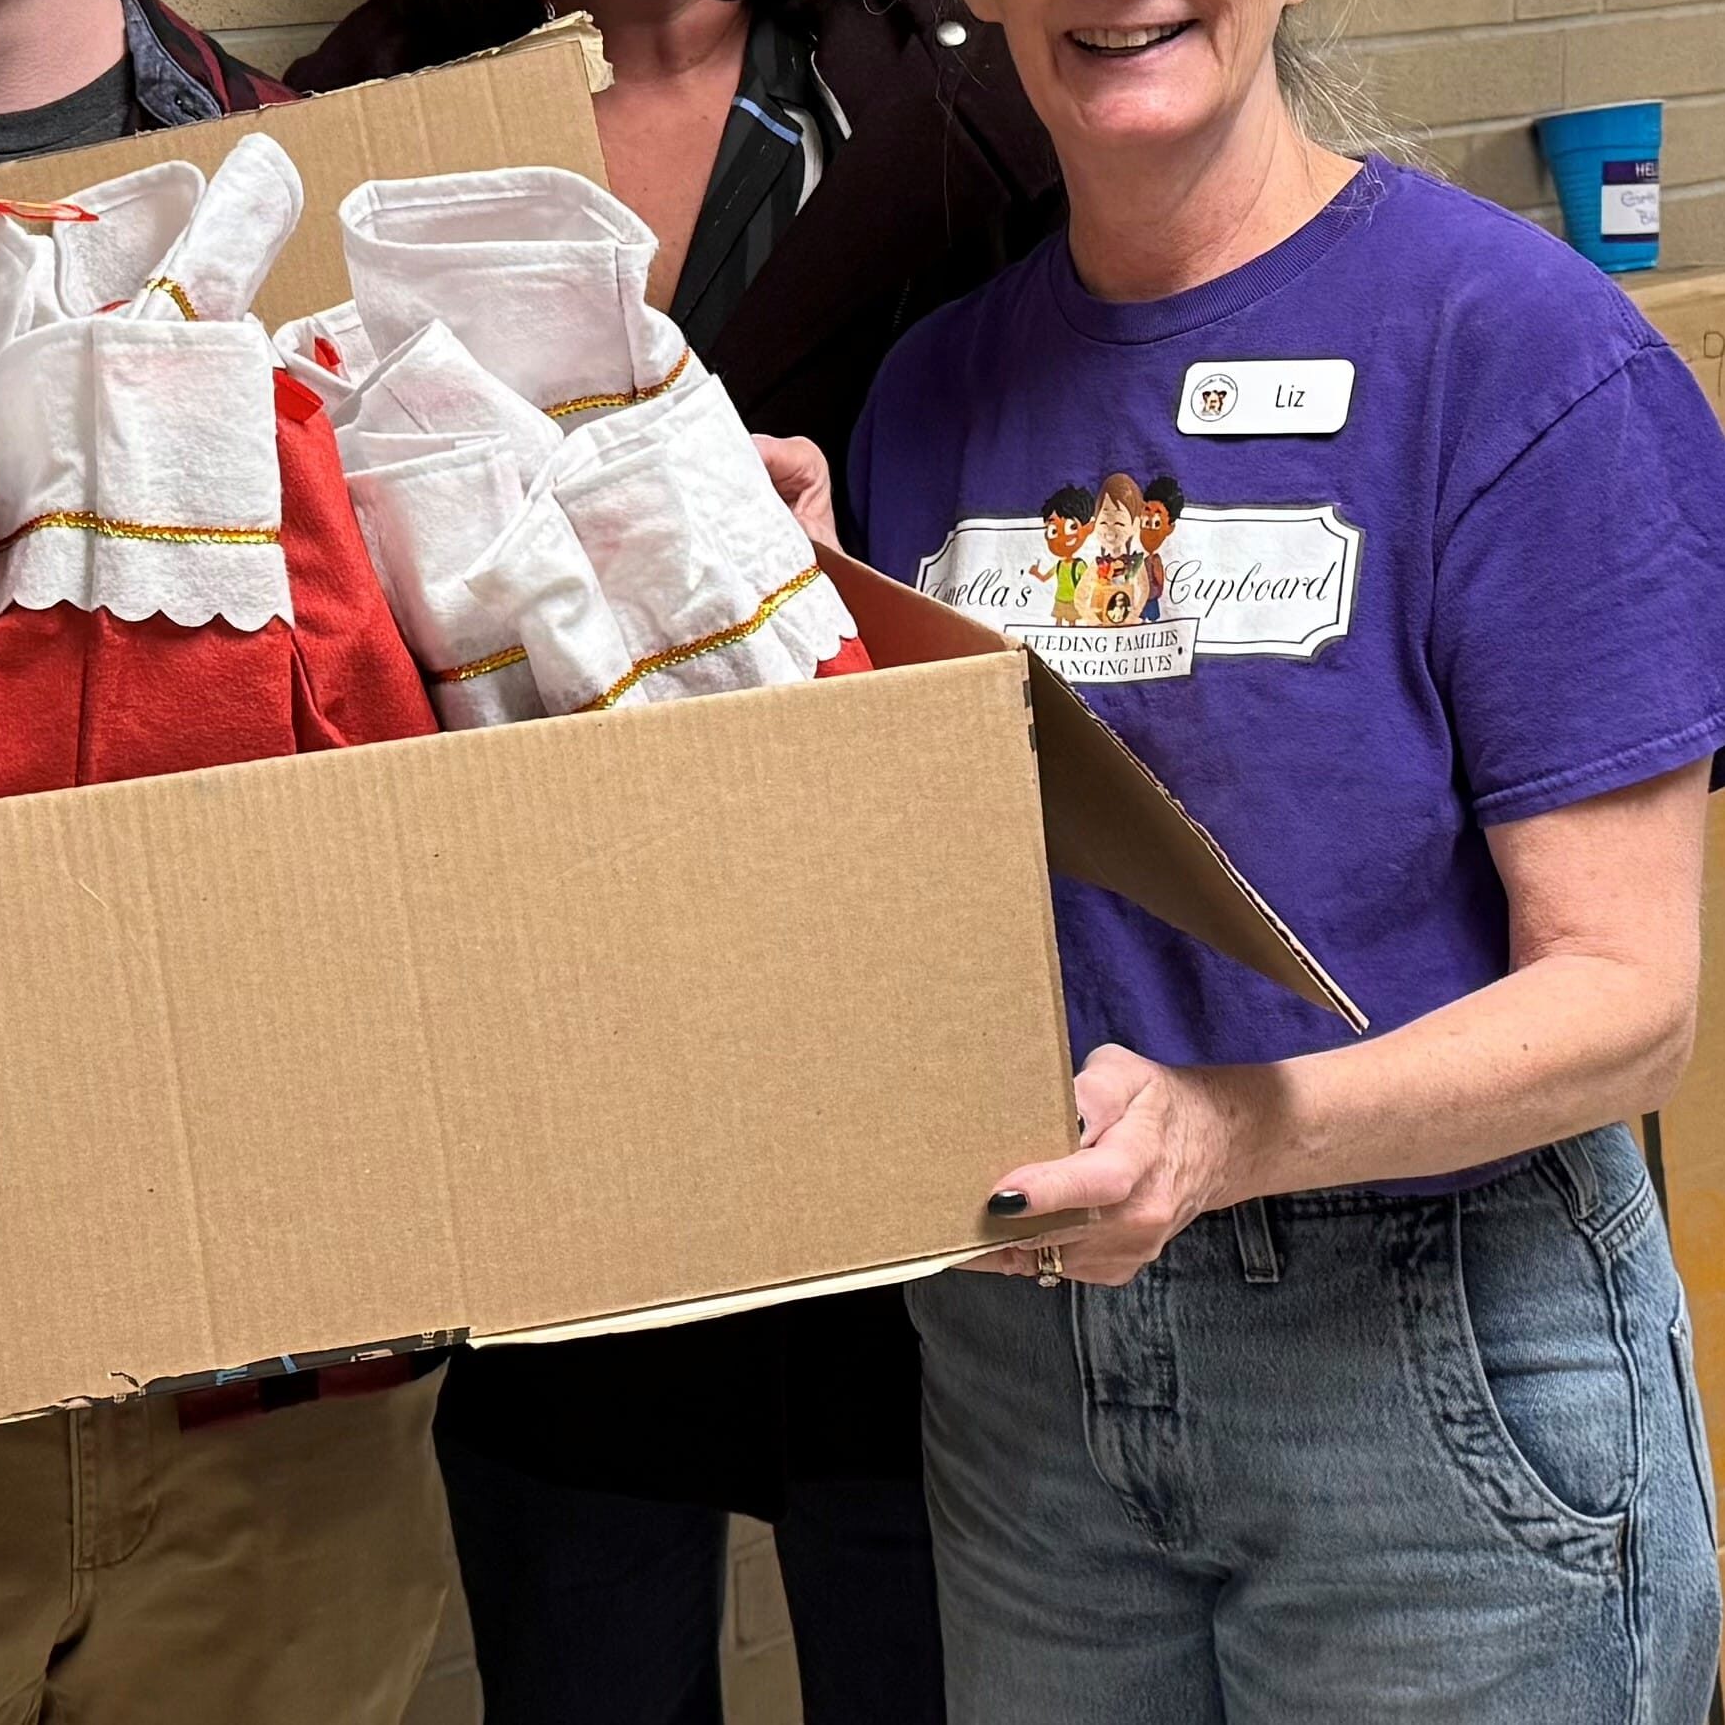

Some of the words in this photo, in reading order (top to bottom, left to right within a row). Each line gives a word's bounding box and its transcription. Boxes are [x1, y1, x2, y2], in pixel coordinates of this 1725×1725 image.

[1275, 384, 1306, 408] Liz
[1165, 560, 1337, 619] Cupboard
[1115, 629, 1179, 653] FAMILIES
[1133, 654, 1173, 674] LIVES
